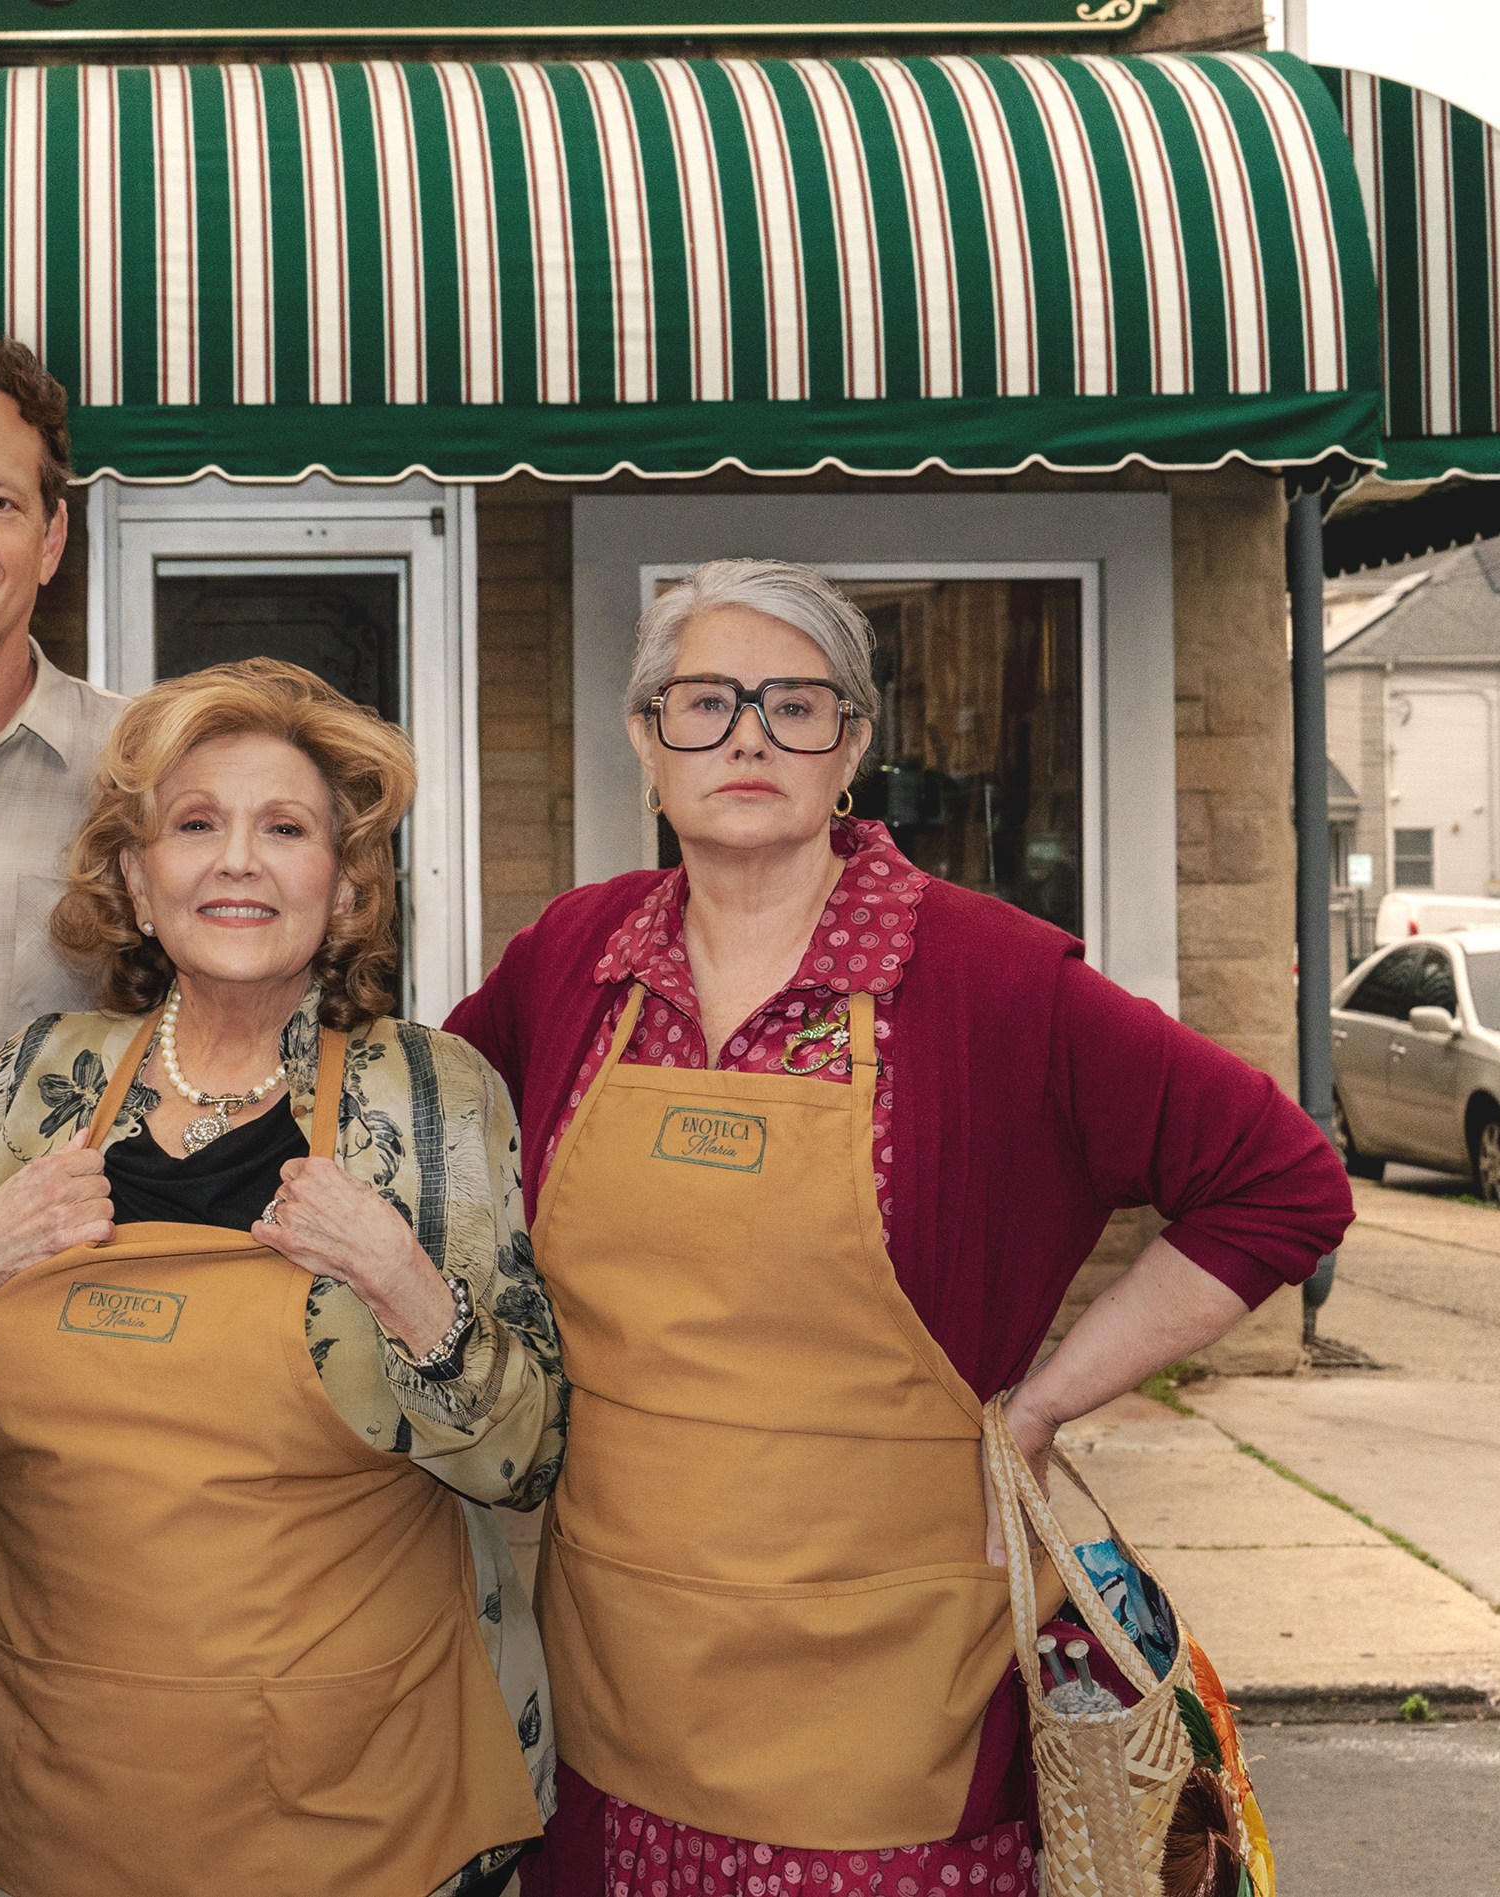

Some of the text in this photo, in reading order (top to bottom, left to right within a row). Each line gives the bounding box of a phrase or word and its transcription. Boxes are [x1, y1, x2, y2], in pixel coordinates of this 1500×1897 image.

[681, 1116, 749, 1140] ENOTECA
[682, 1135, 737, 1157] Maria
[88, 1291, 161, 1314] ENOTECA
[89, 1308, 147, 1329] Maria
